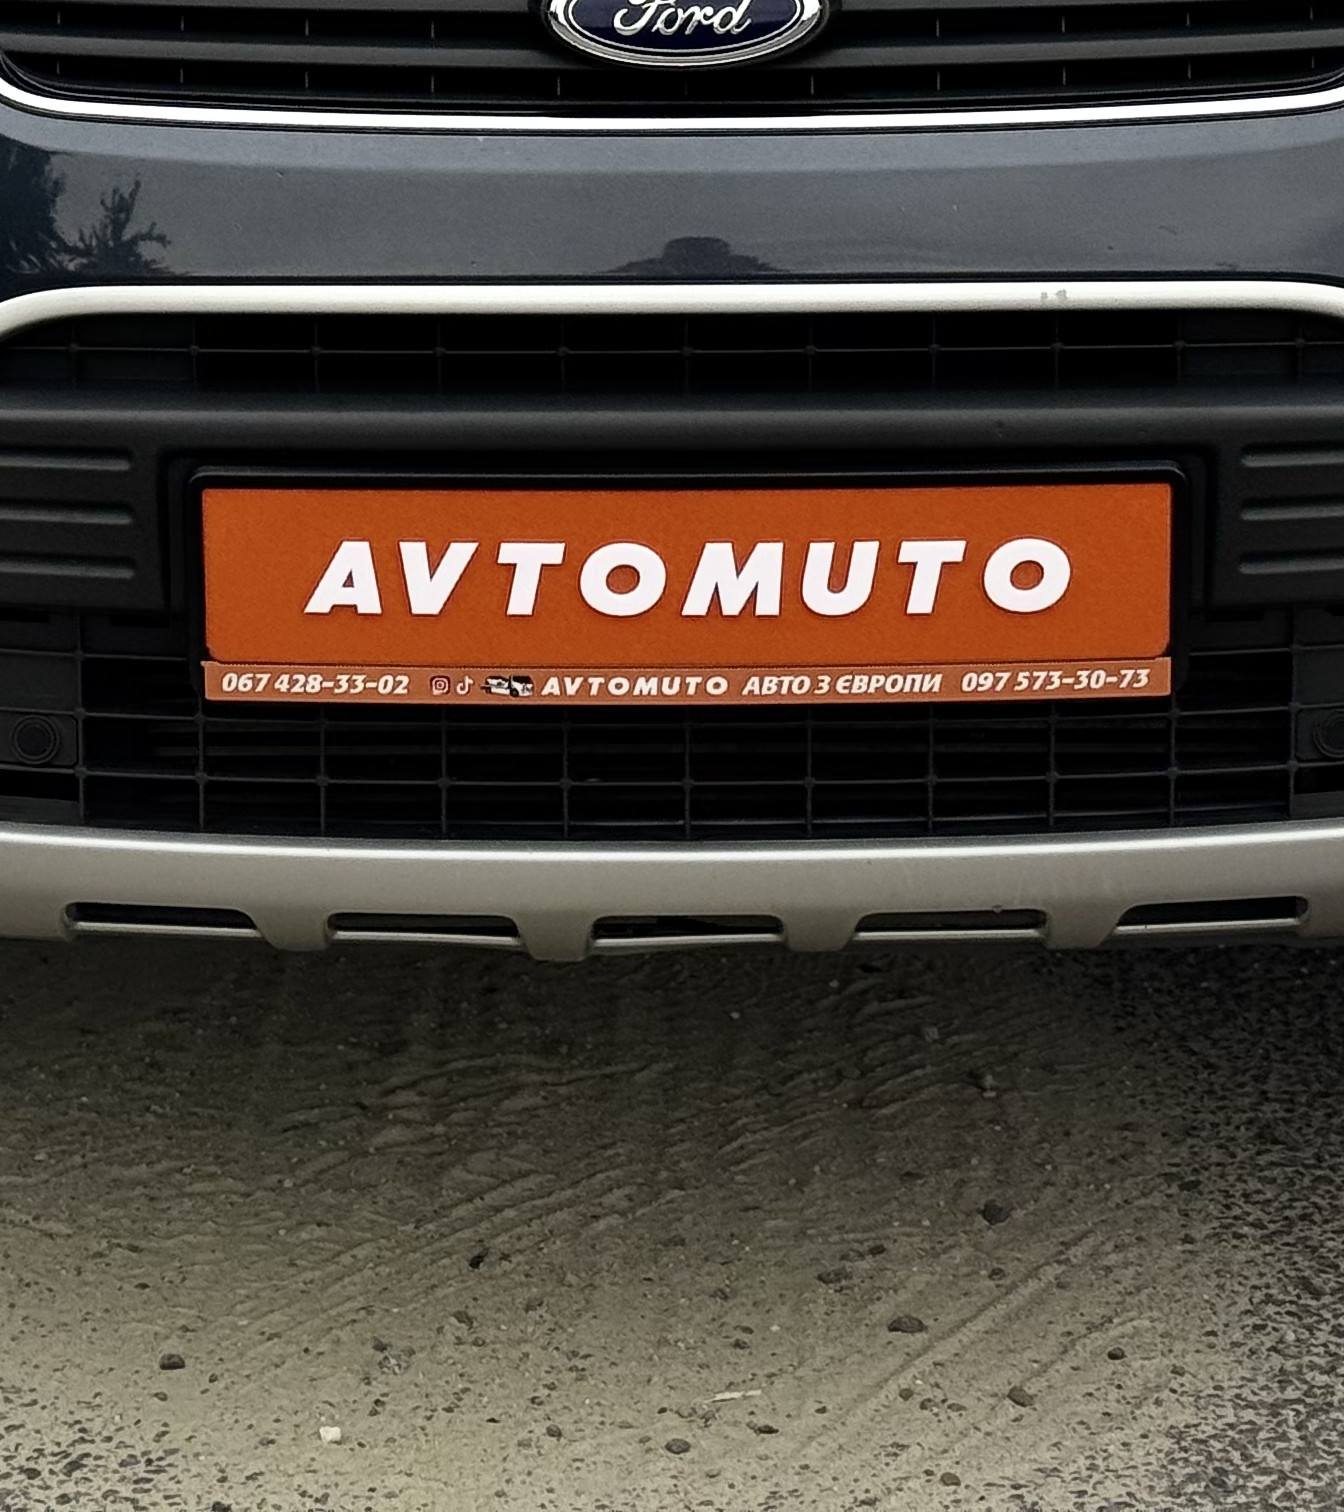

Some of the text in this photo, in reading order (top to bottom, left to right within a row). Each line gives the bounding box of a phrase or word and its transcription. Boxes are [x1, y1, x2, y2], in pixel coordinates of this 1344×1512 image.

[303, 537, 1072, 616] AVTOMUTO
[222, 672, 271, 693] 067
[274, 673, 410, 695] 428-33-02
[541, 676, 729, 696] AVTOMUTO
[742, 675, 809, 696] АВТО
[835, 673, 943, 694] ЄВРОПИ
[961, 671, 1008, 692] 097
[1014, 668, 1150, 692] 573-30-73
